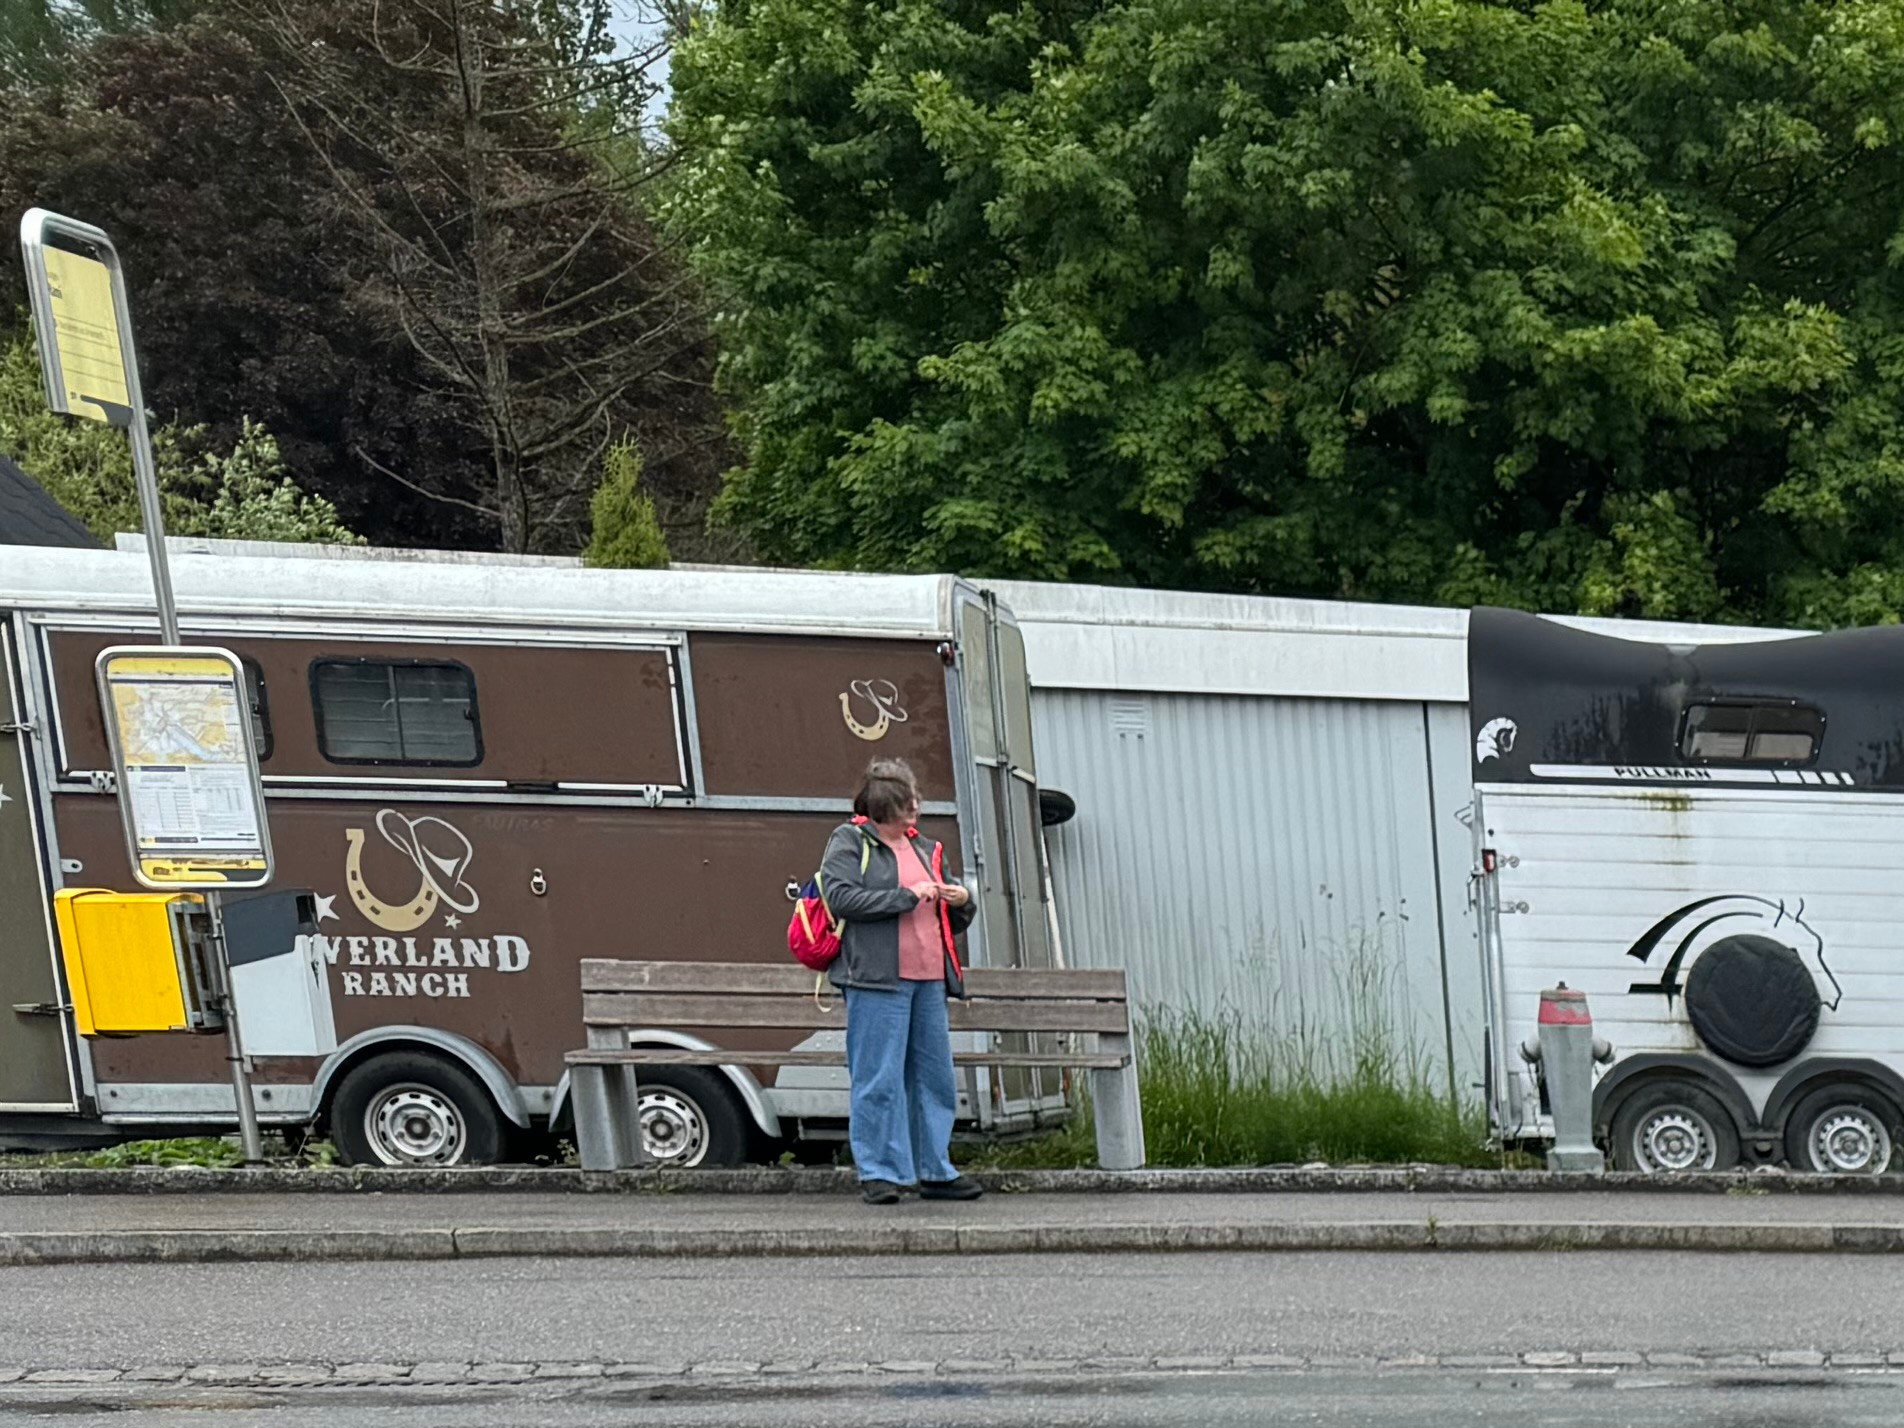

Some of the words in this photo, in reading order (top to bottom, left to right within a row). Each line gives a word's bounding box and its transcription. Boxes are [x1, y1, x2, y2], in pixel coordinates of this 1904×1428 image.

[1613, 766, 1712, 780] PULLMAN
[320, 935, 531, 972] VERLAND
[342, 971, 471, 998] RANCH
